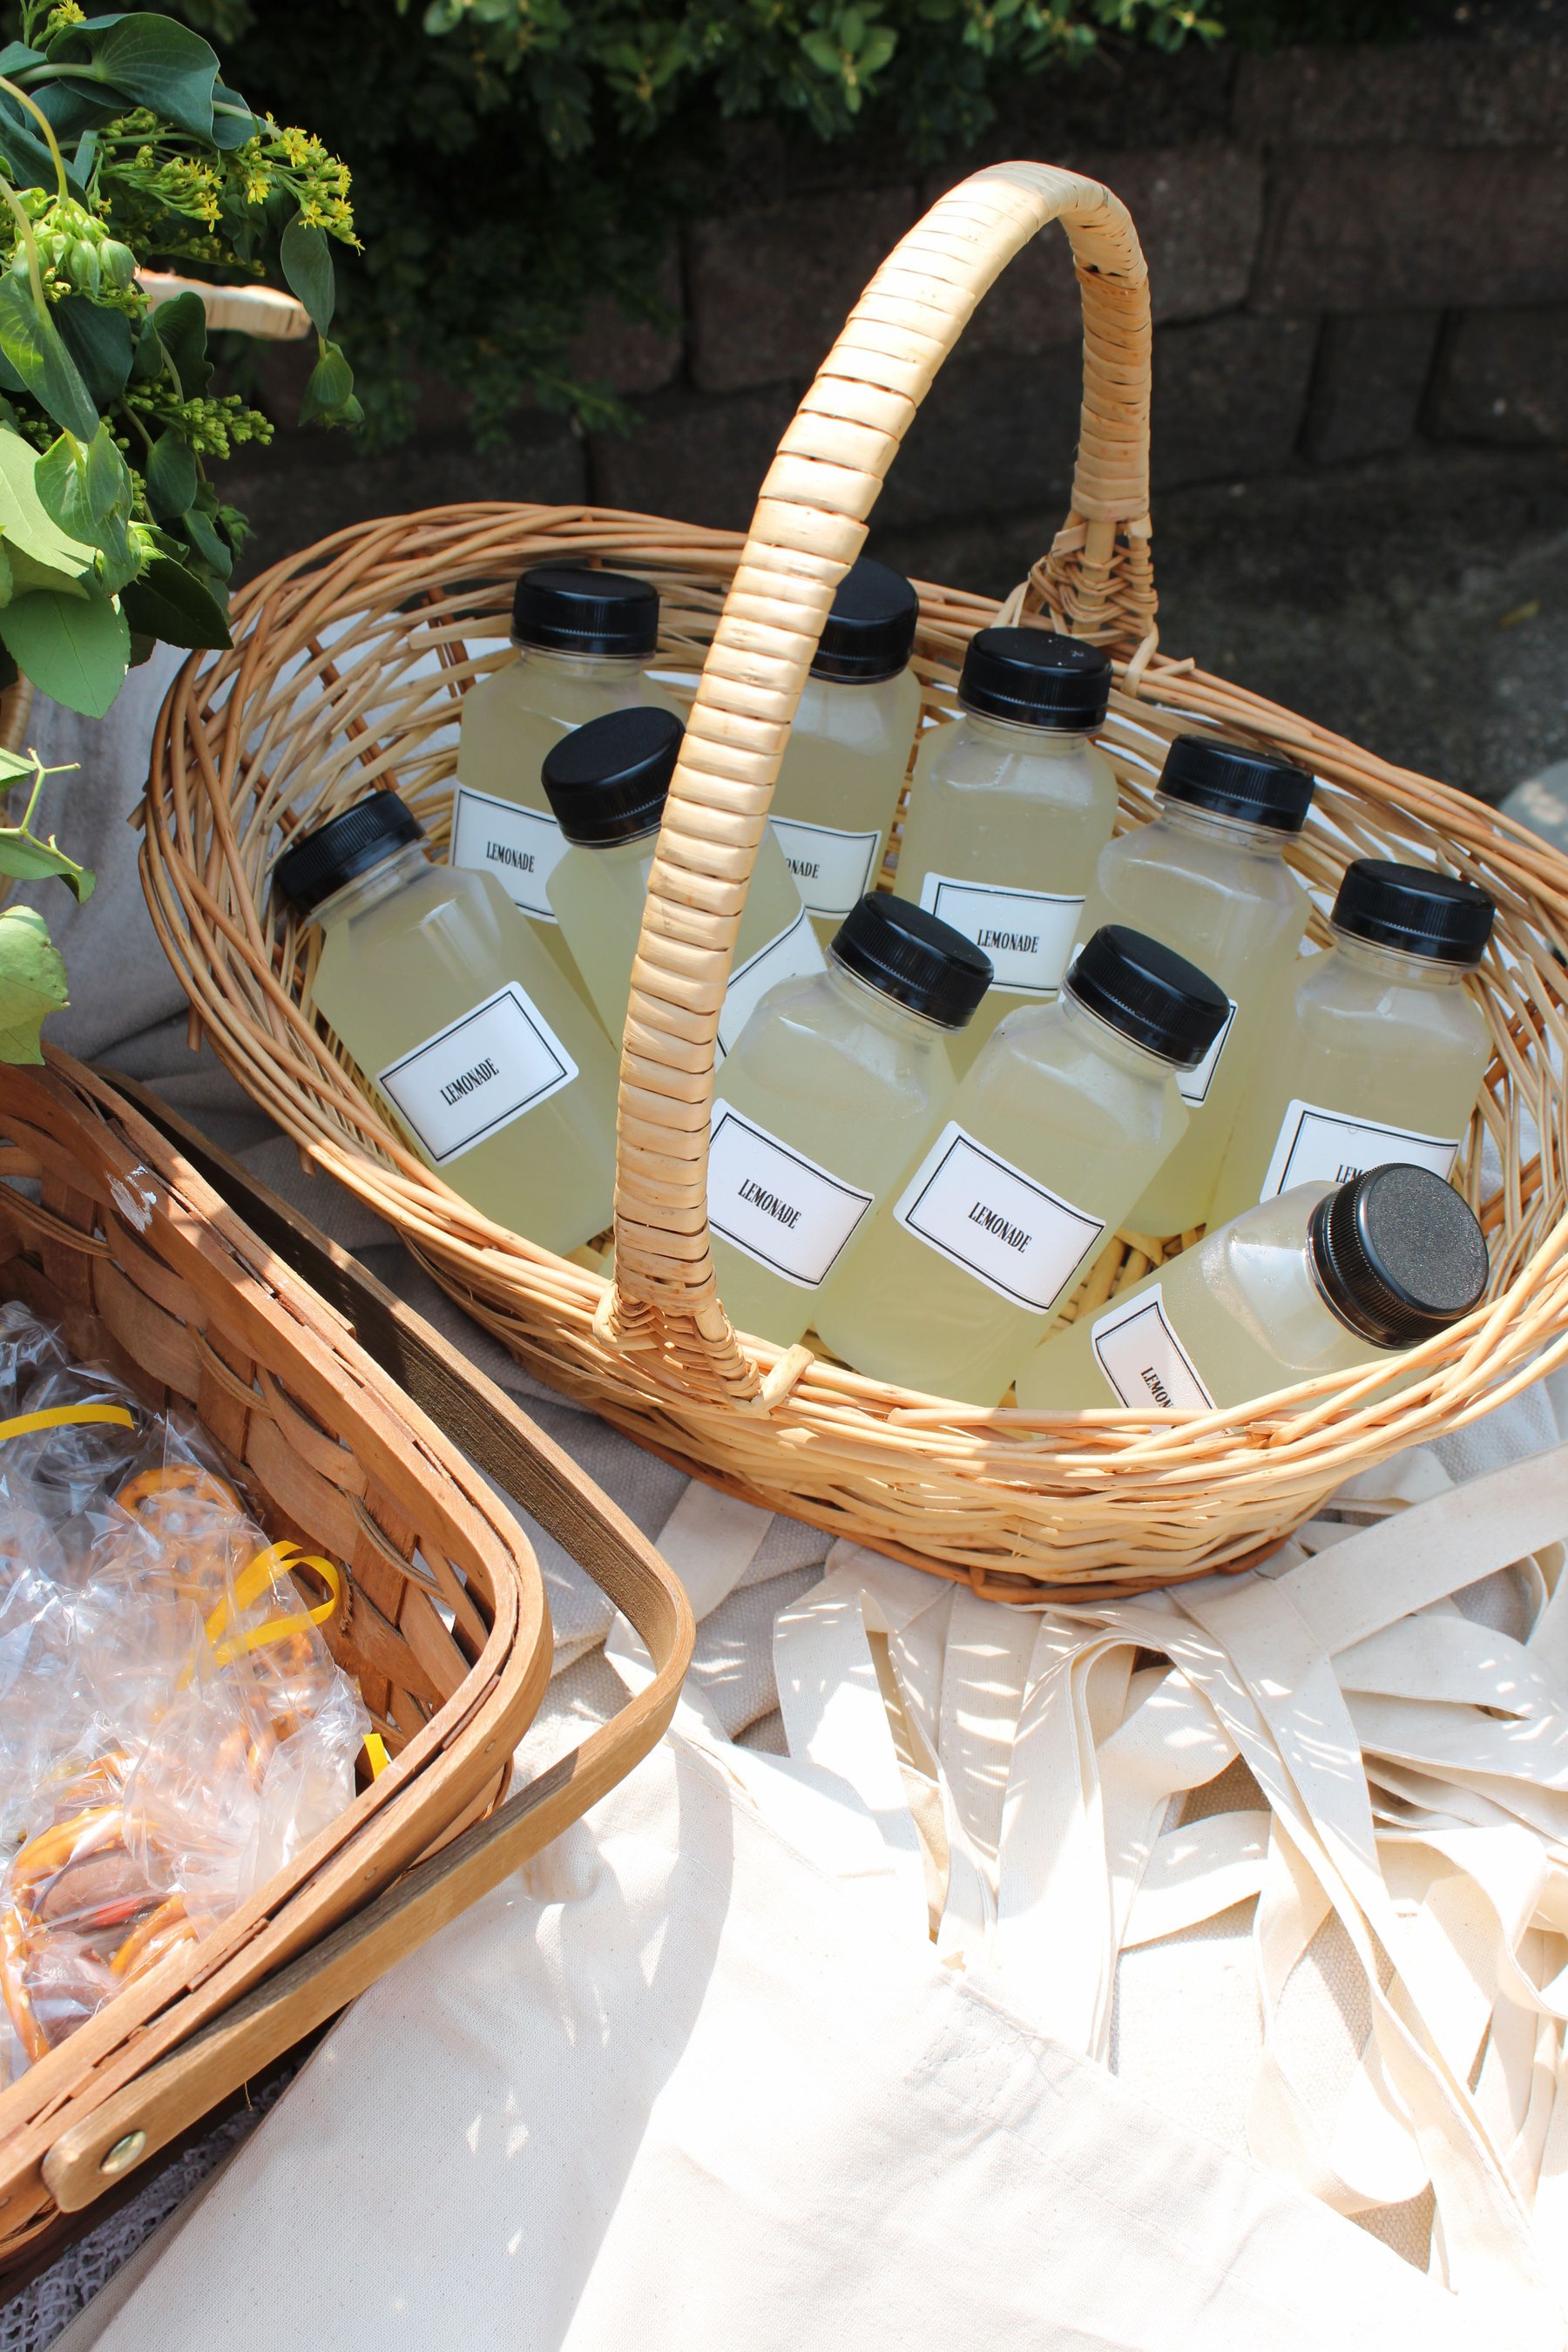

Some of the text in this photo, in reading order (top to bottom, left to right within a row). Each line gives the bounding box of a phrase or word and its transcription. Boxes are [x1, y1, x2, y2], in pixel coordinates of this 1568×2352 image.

[486, 841, 536, 873] LEMONADE
[977, 929, 1040, 954] LEMONADE
[439, 1057, 500, 1106] LEMONADE
[737, 1178, 802, 1230] LEMONADE
[968, 1201, 1033, 1254] LEMONADE
